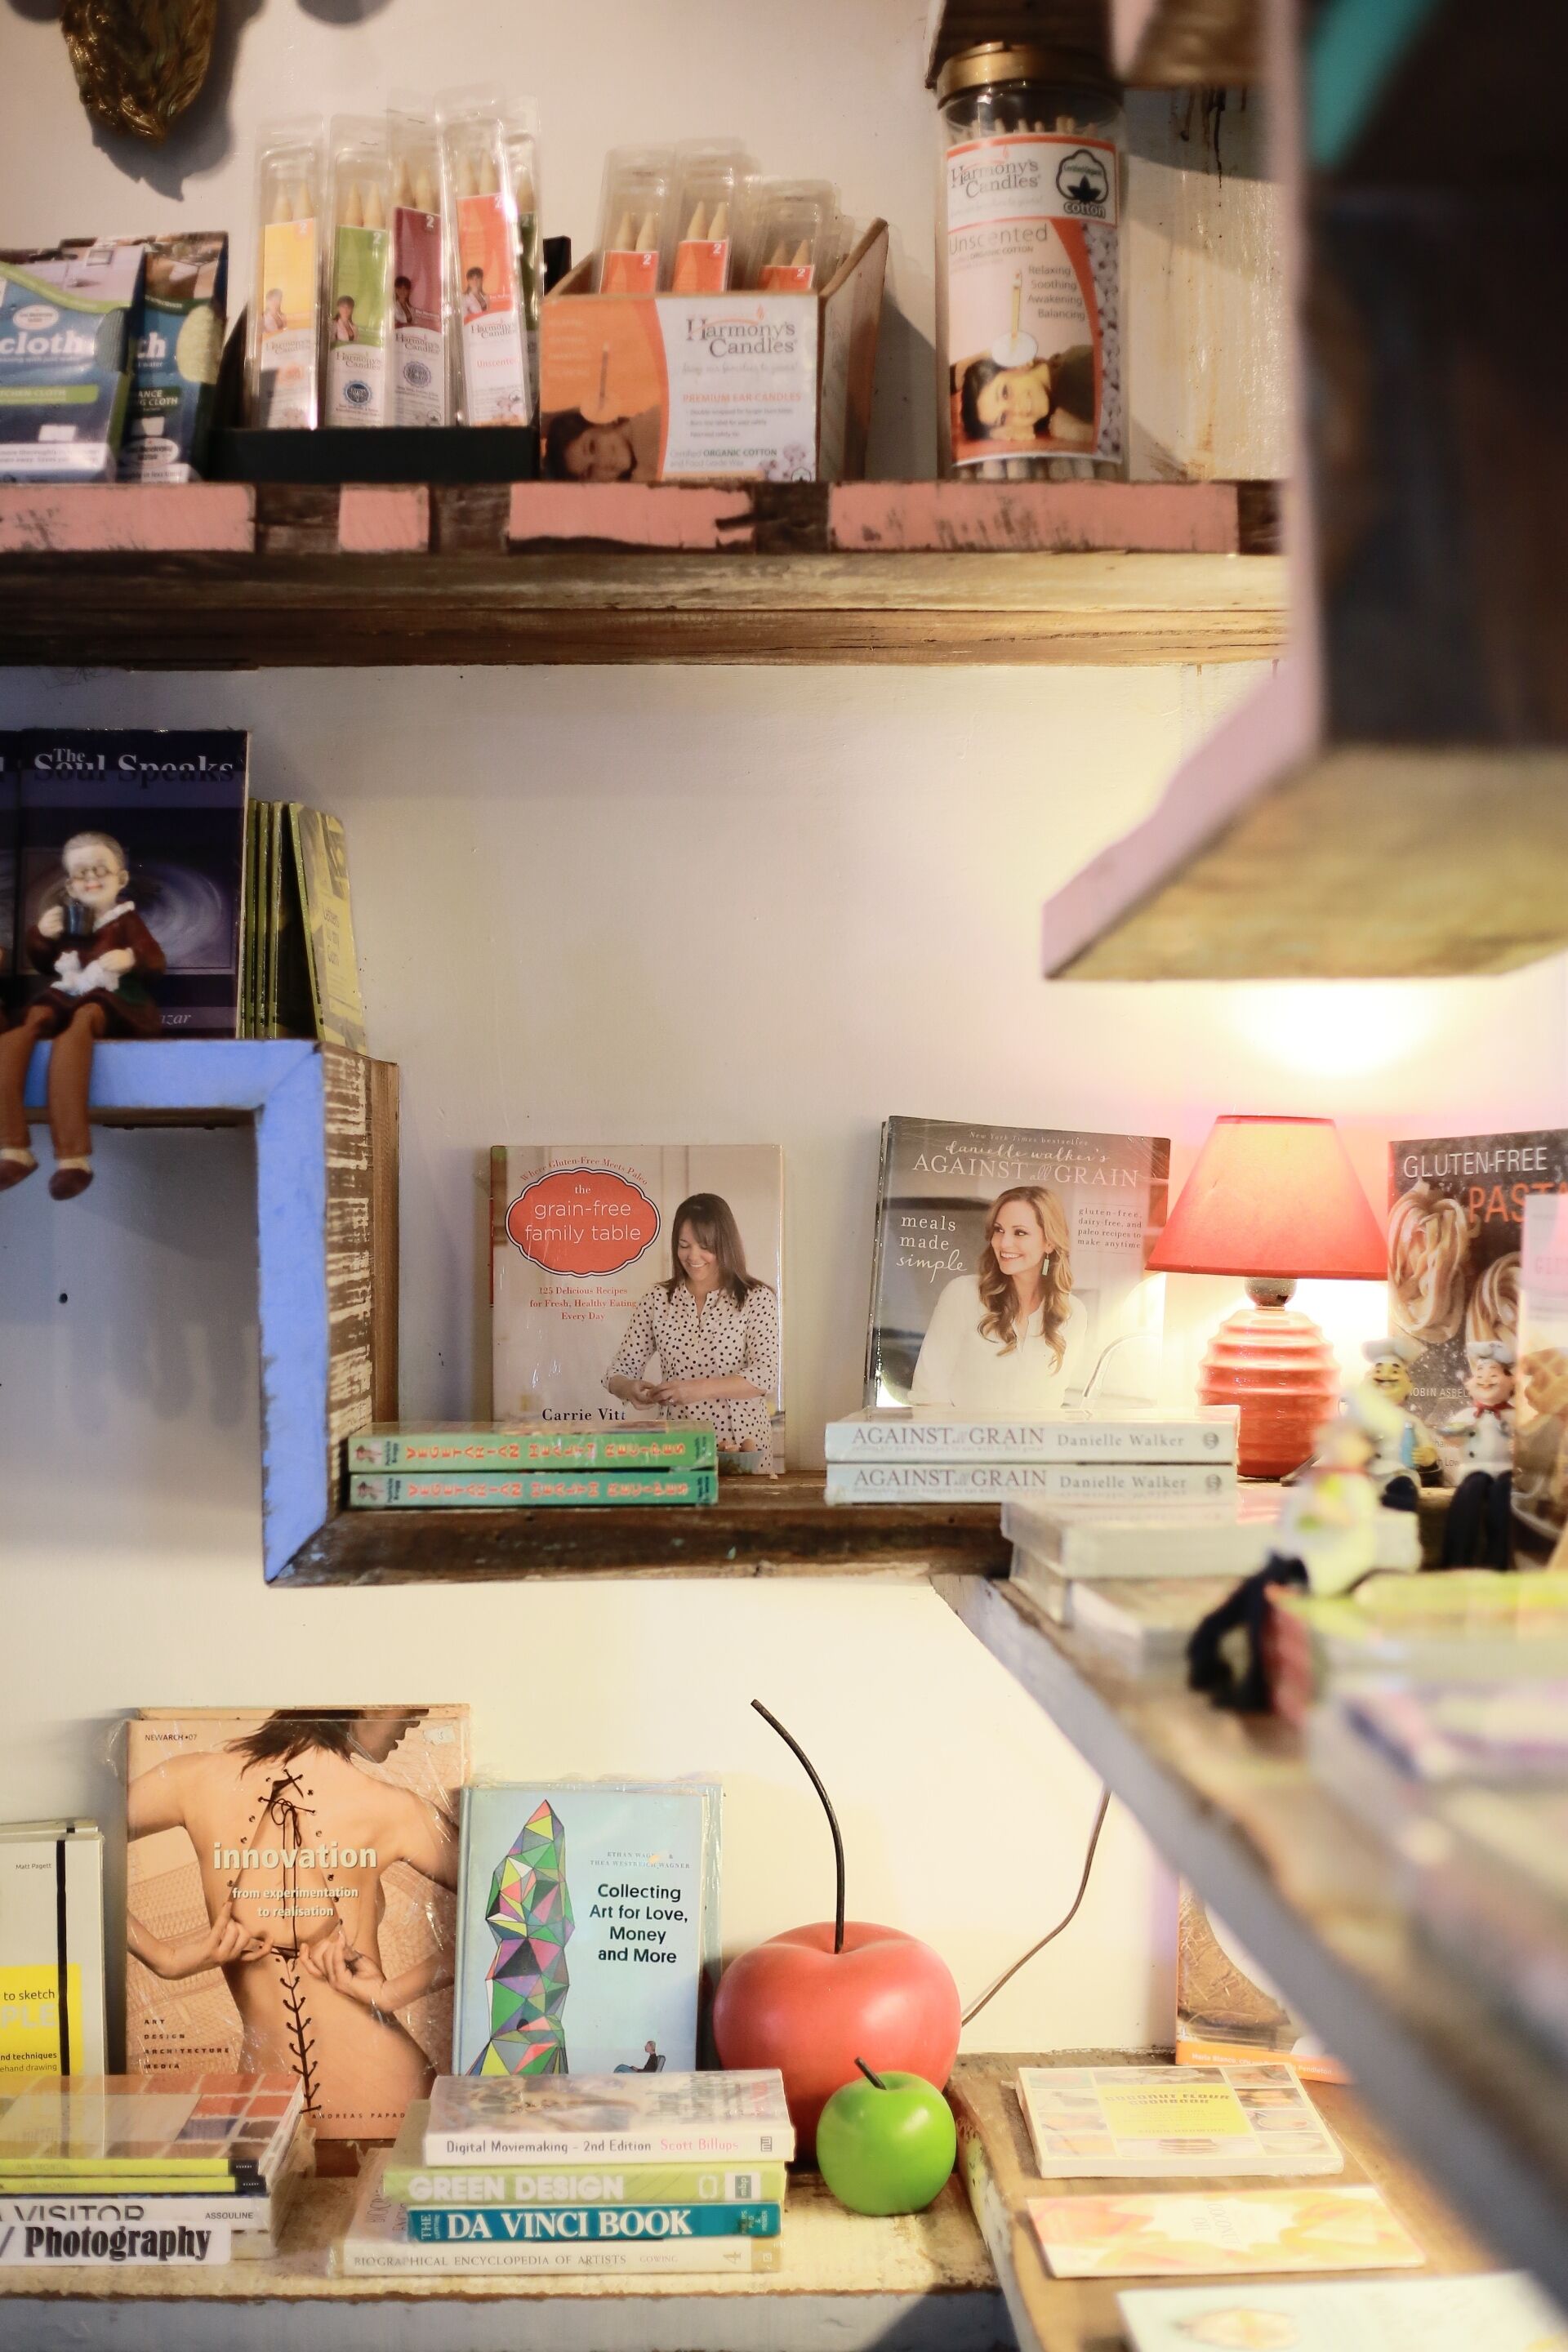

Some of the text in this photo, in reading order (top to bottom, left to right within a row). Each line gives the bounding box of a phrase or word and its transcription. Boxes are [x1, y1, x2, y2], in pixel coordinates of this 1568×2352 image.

[966, 172, 1039, 198] Candles
[1063, 202, 1106, 219] cotton
[426, 216, 434, 228] 2
[373, 232, 381, 244] 2
[948, 222, 1049, 255] Unscented
[713, 244, 721, 253] 2
[643, 254, 652, 265] 2
[797, 269, 804, 278] 2
[1028, 265, 1071, 277] Relaxing
[1031, 279, 1077, 291] Soothing
[1028, 294, 1083, 306] Awakening
[1038, 308, 1085, 320] Balancing
[686, 318, 795, 341] Harmony's
[709, 336, 795, 358] Candles
[683, 394, 729, 403] PREMIUM
[755, 393, 802, 402] CANDLES
[703, 449, 777, 457] ORGANIC COTTON
[53, 748, 85, 762] The
[34, 753, 106, 782] Soul
[118, 755, 234, 789] Speaks
[969, 1131, 986, 1139] New
[991, 1133, 1008, 1141] York
[1012, 1135, 1037, 1143] Times
[945, 1140, 1111, 1163] danielle walker's
[1404, 1147, 1548, 1178] GLUTEN-FREE
[520, 1156, 648, 1185] Where Gluten-Free Meets Paleo
[912, 1153, 1139, 1188] AGAINST all GRAIN
[575, 1185, 591, 1194] the
[534, 1200, 631, 1220] grain-free
[901, 1214, 956, 1232] meals
[525, 1224, 641, 1244] family table
[1102, 1231, 1130, 1239] recipes
[899, 1234, 949, 1251] made
[1105, 1241, 1141, 1250] anytime
[896, 1249, 968, 1285] simple
[556, 1286, 593, 1294] Delicious
[596, 1287, 627, 1296] Recipes
[530, 1299, 637, 1310] for Fresh, Healthy Eating
[562, 1312, 605, 1321] Every Day
[542, 1408, 626, 1421] Carrie Vitt
[853, 1428, 1184, 1446] AGAINST GRAIN Danielle Walker
[406, 1444, 519, 1459] VEGETARIAN
[605, 1443, 685, 1458] RECIPES
[854, 1469, 1187, 1488] AGAINST GRAIN Danielle Walker
[408, 1482, 522, 1498] VEGETARIAN
[608, 1483, 688, 1498] RECIPES
[212, 1842, 377, 1869] innovation
[232, 1886, 359, 1901] from experimentation
[597, 1883, 682, 1903] Collecting
[258, 1905, 335, 1917] to realisation
[590, 1904, 688, 1923] Art for Love,
[609, 1927, 666, 1944] Money
[598, 1948, 677, 1963] and More
[4, 1989, 56, 2001] to sketch
[12, 2051, 57, 2062] techniques
[25, 2063, 57, 2074] drawing
[1298, 2065, 1332, 2075] Pendleton
[446, 2137, 739, 2155] Digital Moviemaking 2nd Edition Scott Billups
[409, 2176, 624, 2202] GREEN DESIGN
[205, 2212, 253, 2220] ASSOULINE
[448, 2208, 693, 2238] DA VINCI BOOK
[421, 2214, 432, 2239] THE
[24, 2225, 212, 2261] Photography
[354, 2256, 447, 2265] BIOGRAPHICAL
[455, 2256, 549, 2265] ENCYCLOPEDIA
[555, 2255, 571, 2265] OF
[577, 2255, 626, 2265] ARTISTS
